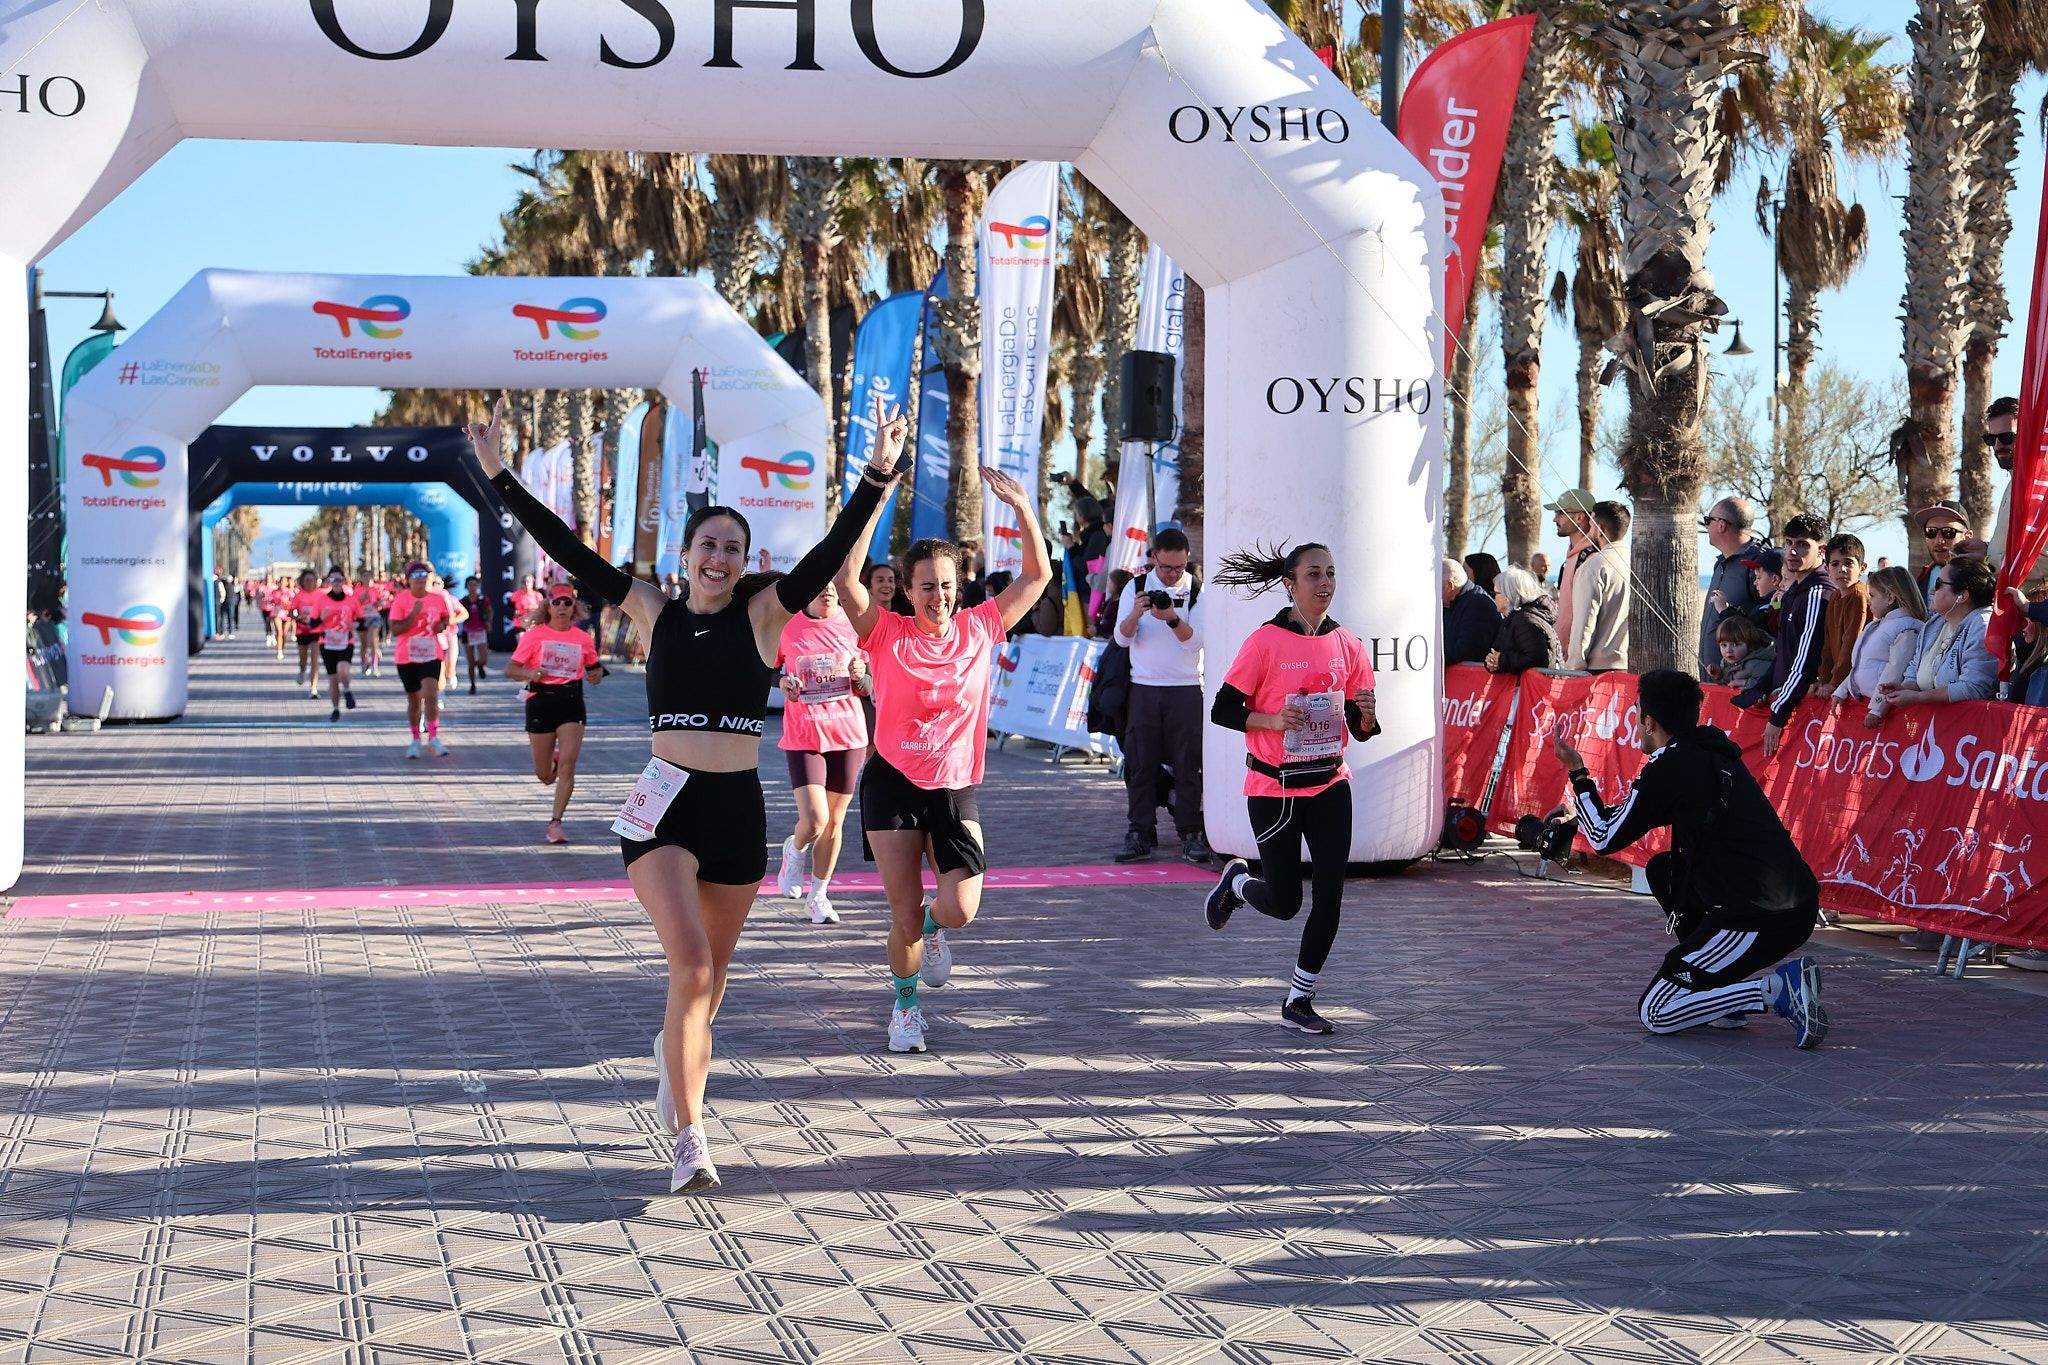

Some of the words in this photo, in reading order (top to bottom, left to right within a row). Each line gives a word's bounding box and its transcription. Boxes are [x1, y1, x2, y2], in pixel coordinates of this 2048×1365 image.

[1168, 105, 1350, 144] OYSHO
[313, 347, 412, 362] TotalEnergies
[513, 349, 608, 363] TotalEnergies
[1266, 377, 1431, 415] OYSHO
[251, 445, 429, 463] VOLVO
[82, 496, 166, 510] TotalEnergies
[739, 496, 815, 512] TotalEnergies
[81, 654, 166, 667] TotalEnergies
[658, 713, 709, 728] PRO
[718, 715, 765, 733] NIKE
[1309, 719, 1330, 732] 016
[1796, 719, 1899, 783] Sports
